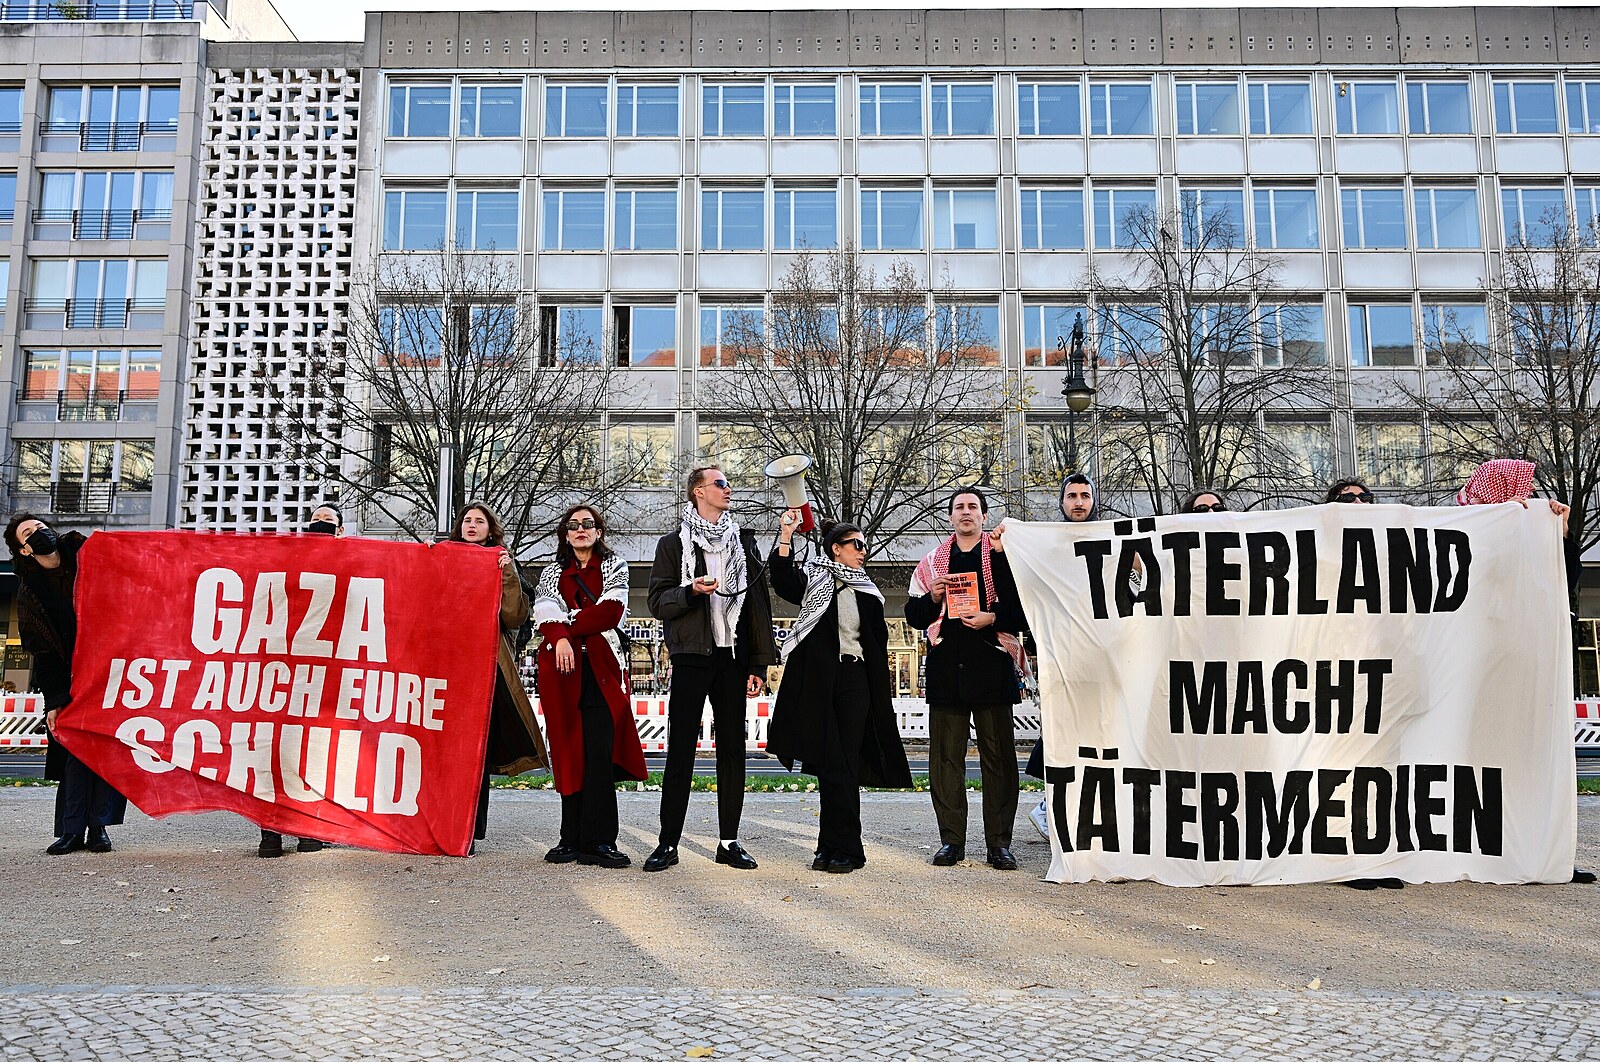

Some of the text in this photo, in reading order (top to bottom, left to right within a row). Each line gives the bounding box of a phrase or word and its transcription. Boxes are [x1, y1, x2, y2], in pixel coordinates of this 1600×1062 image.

[191, 567, 387, 663] GAZA
[1074, 518, 1472, 619] TÄTERLAND
[102, 657, 448, 731] IST AUCH EURE
[1168, 659, 1393, 735] MACHT
[114, 716, 422, 816] SCHULD
[1045, 746, 1502, 862] TÄTERMEDIEN
